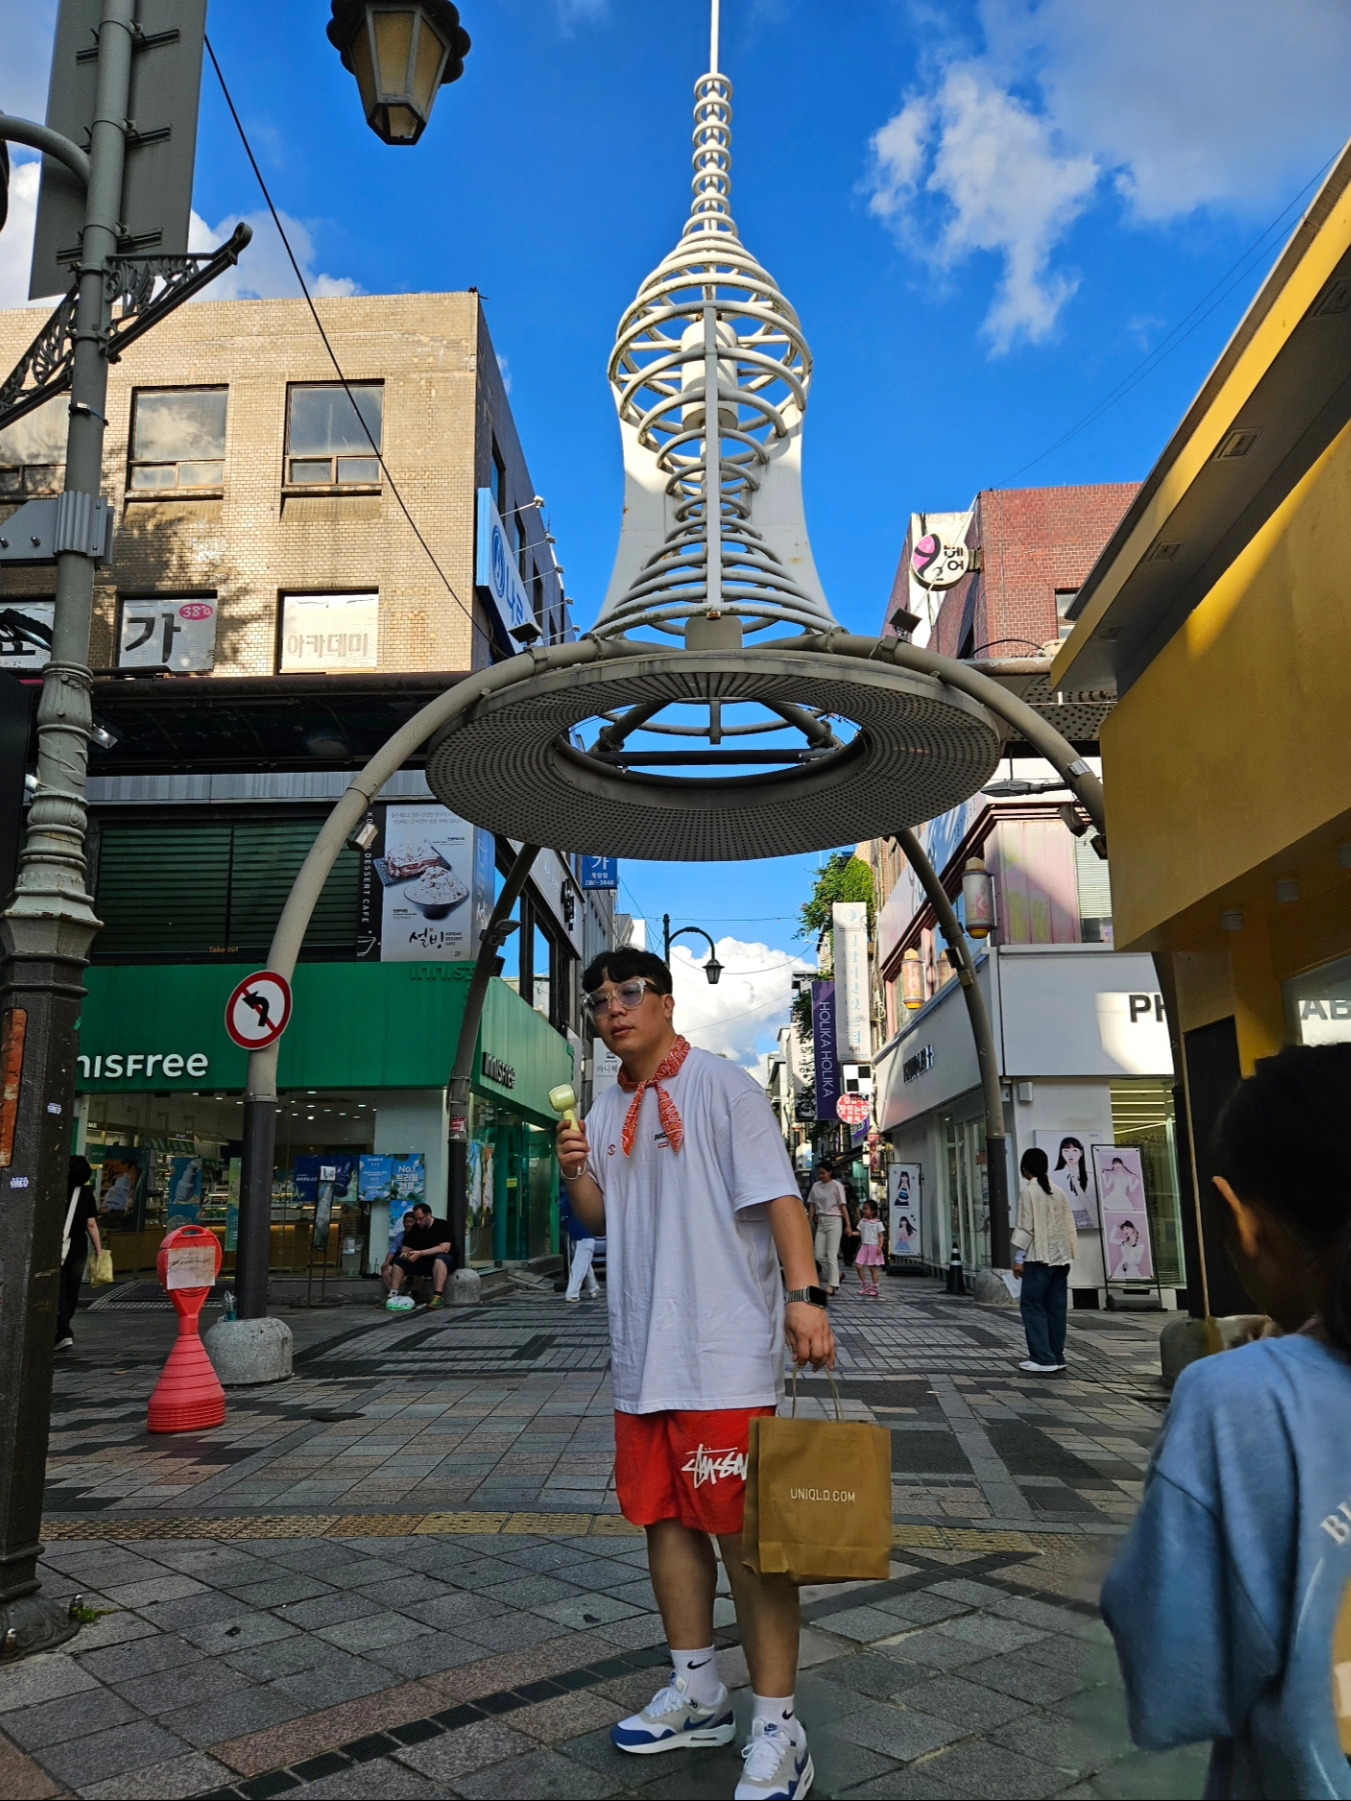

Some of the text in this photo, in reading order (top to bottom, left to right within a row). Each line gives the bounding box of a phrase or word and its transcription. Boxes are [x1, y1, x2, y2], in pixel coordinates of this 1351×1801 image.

[286, 633, 368, 658] 아카데미
[363, 852, 372, 895] DESSERT
[361, 898, 370, 923] CAFE
[409, 927, 444, 949] 설빙
[819, 1002, 835, 1098] HOLIKA HOLIKA
[398, 1165, 416, 1173] No.1
[790, 1488, 856, 1503] UNIQLO.COM
